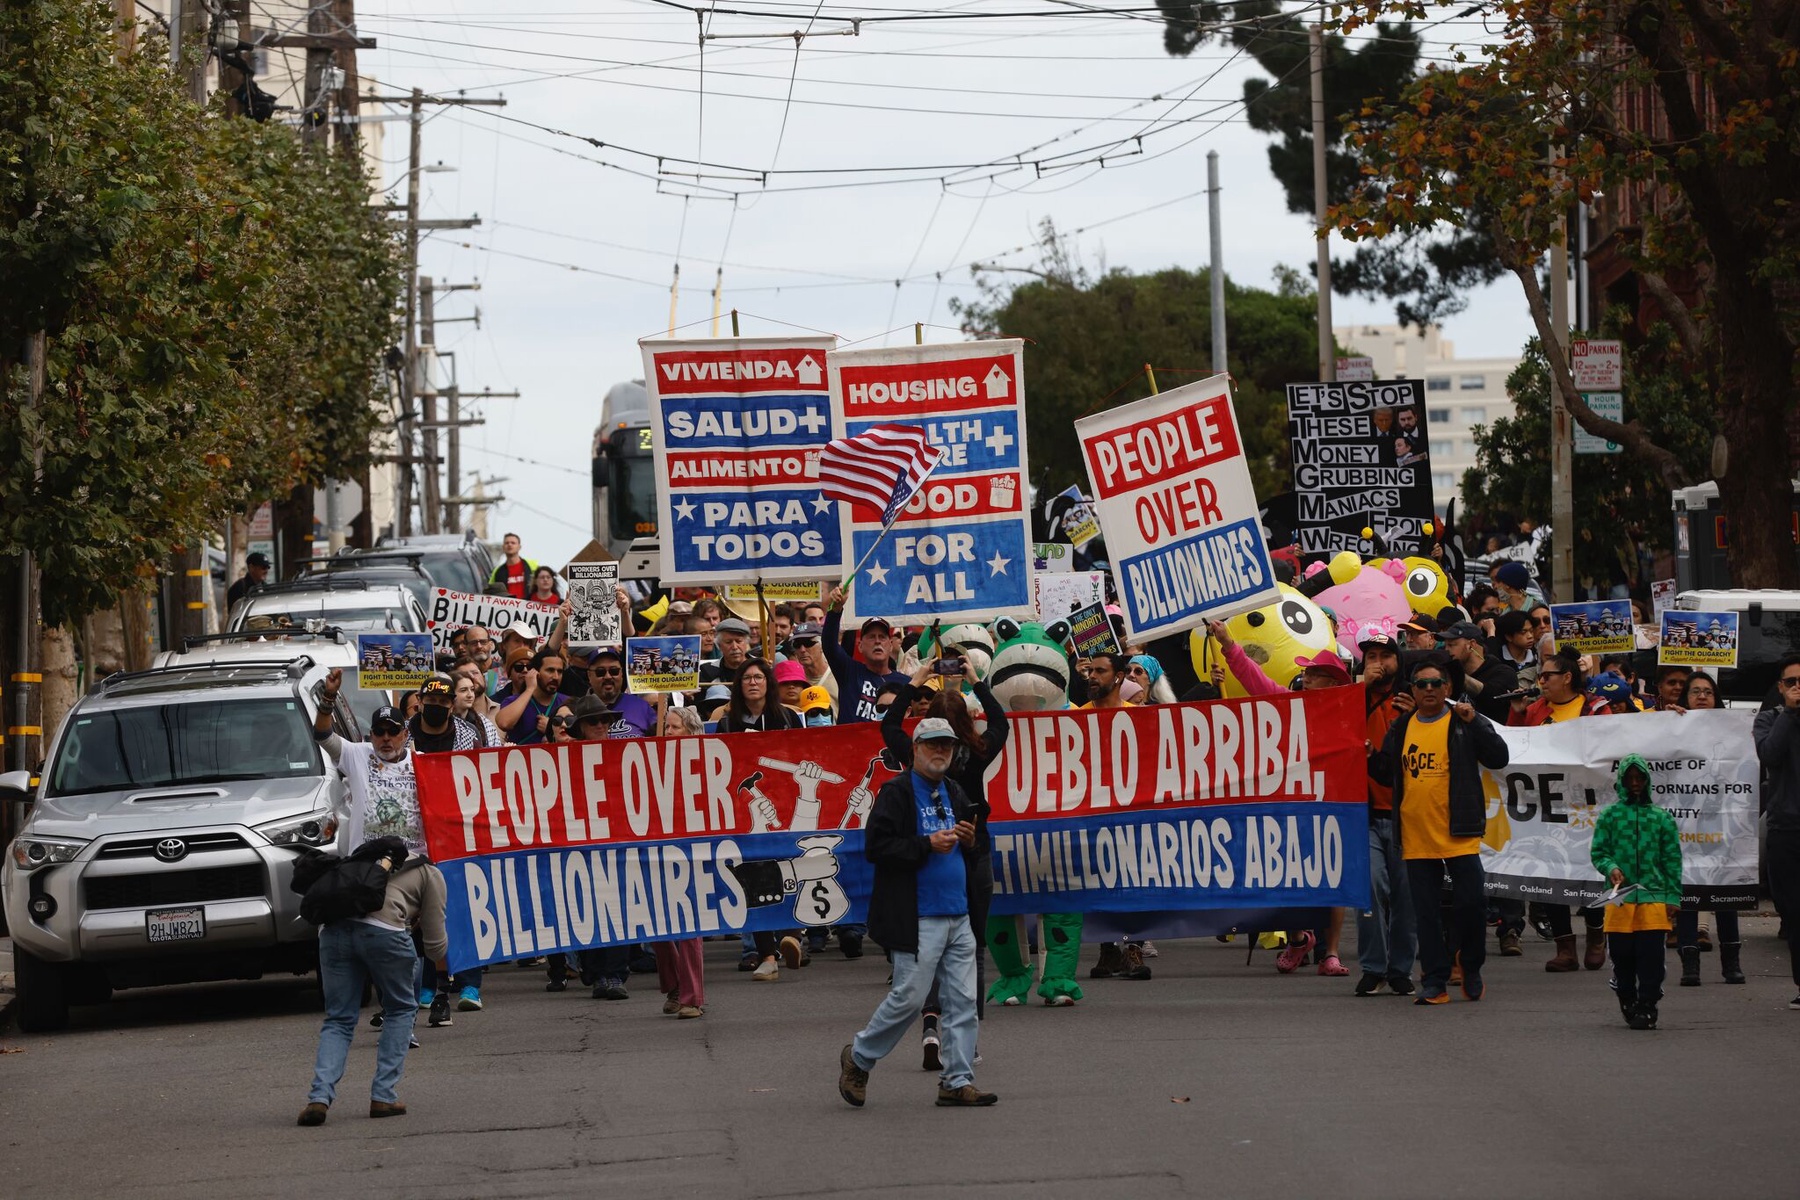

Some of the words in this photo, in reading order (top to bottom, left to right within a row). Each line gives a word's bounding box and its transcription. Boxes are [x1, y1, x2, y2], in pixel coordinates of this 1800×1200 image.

[1574, 343, 1587, 356] NO
[1588, 344, 1619, 355] PARKING
[661, 360, 795, 381] VIVIENDA
[1575, 361, 1584, 370] 12
[1606, 360, 1612, 369] 2
[848, 376, 978, 404] HOUSING
[1288, 385, 1343, 411] LET'S
[1594, 395, 1616, 403] HOUR
[668, 408, 797, 438] SALUD
[1292, 412, 1370, 439] THESE
[1095, 405, 1223, 489] PEOPLE
[1294, 439, 1377, 464] MONEY
[671, 457, 802, 479] ALIMENTO
[1296, 463, 1414, 489] GRUBBING
[905, 484, 979, 515] OOD
[1135, 477, 1223, 545] OVER
[1300, 490, 1400, 520] MANIACS
[703, 500, 808, 528] PARA
[692, 530, 825, 561] TODOS
[895, 532, 976, 567] FOR
[1510, 547, 1525, 558] GET
[575, 571, 613, 579] BILLIONAIRES
[904, 571, 975, 605] ALL
[1128, 526, 1263, 624] BILLIONAIRES
[450, 591, 475, 602] GIVE
[492, 598, 521, 609] AWAY
[525, 602, 547, 613] GIVE
[433, 597, 560, 637] BILLIONAI
[1072, 612, 1103, 635] MINORITY
[1078, 641, 1090, 653] THIS
[1089, 631, 1111, 648] COUNTRY
[1592, 637, 1629, 646] OLIGARCHY
[1664, 649, 1683, 657] FIGHT
[1697, 650, 1732, 658] OLIGARCHY
[661, 675, 694, 683] OLIGARCHY
[1153, 698, 1326, 803] ARRIBA,
[1688, 760, 1706, 770] OF
[451, 744, 612, 853] PEOPLE
[621, 738, 736, 837] OVER
[1725, 784, 1752, 794] FOR
[992, 817, 1235, 895] TIMILLONARIOS
[1244, 815, 1343, 890] ABAJO
[464, 839, 748, 961] BILLIONAIRES
[1484, 881, 1509, 890] ngeles
[1519, 885, 1553, 895] Oakland
[1563, 889, 1578, 897] San
[1579, 889, 1603, 899] Franci
[1680, 895, 1701, 904] ounty
[1710, 895, 1756, 903] Sacramento
